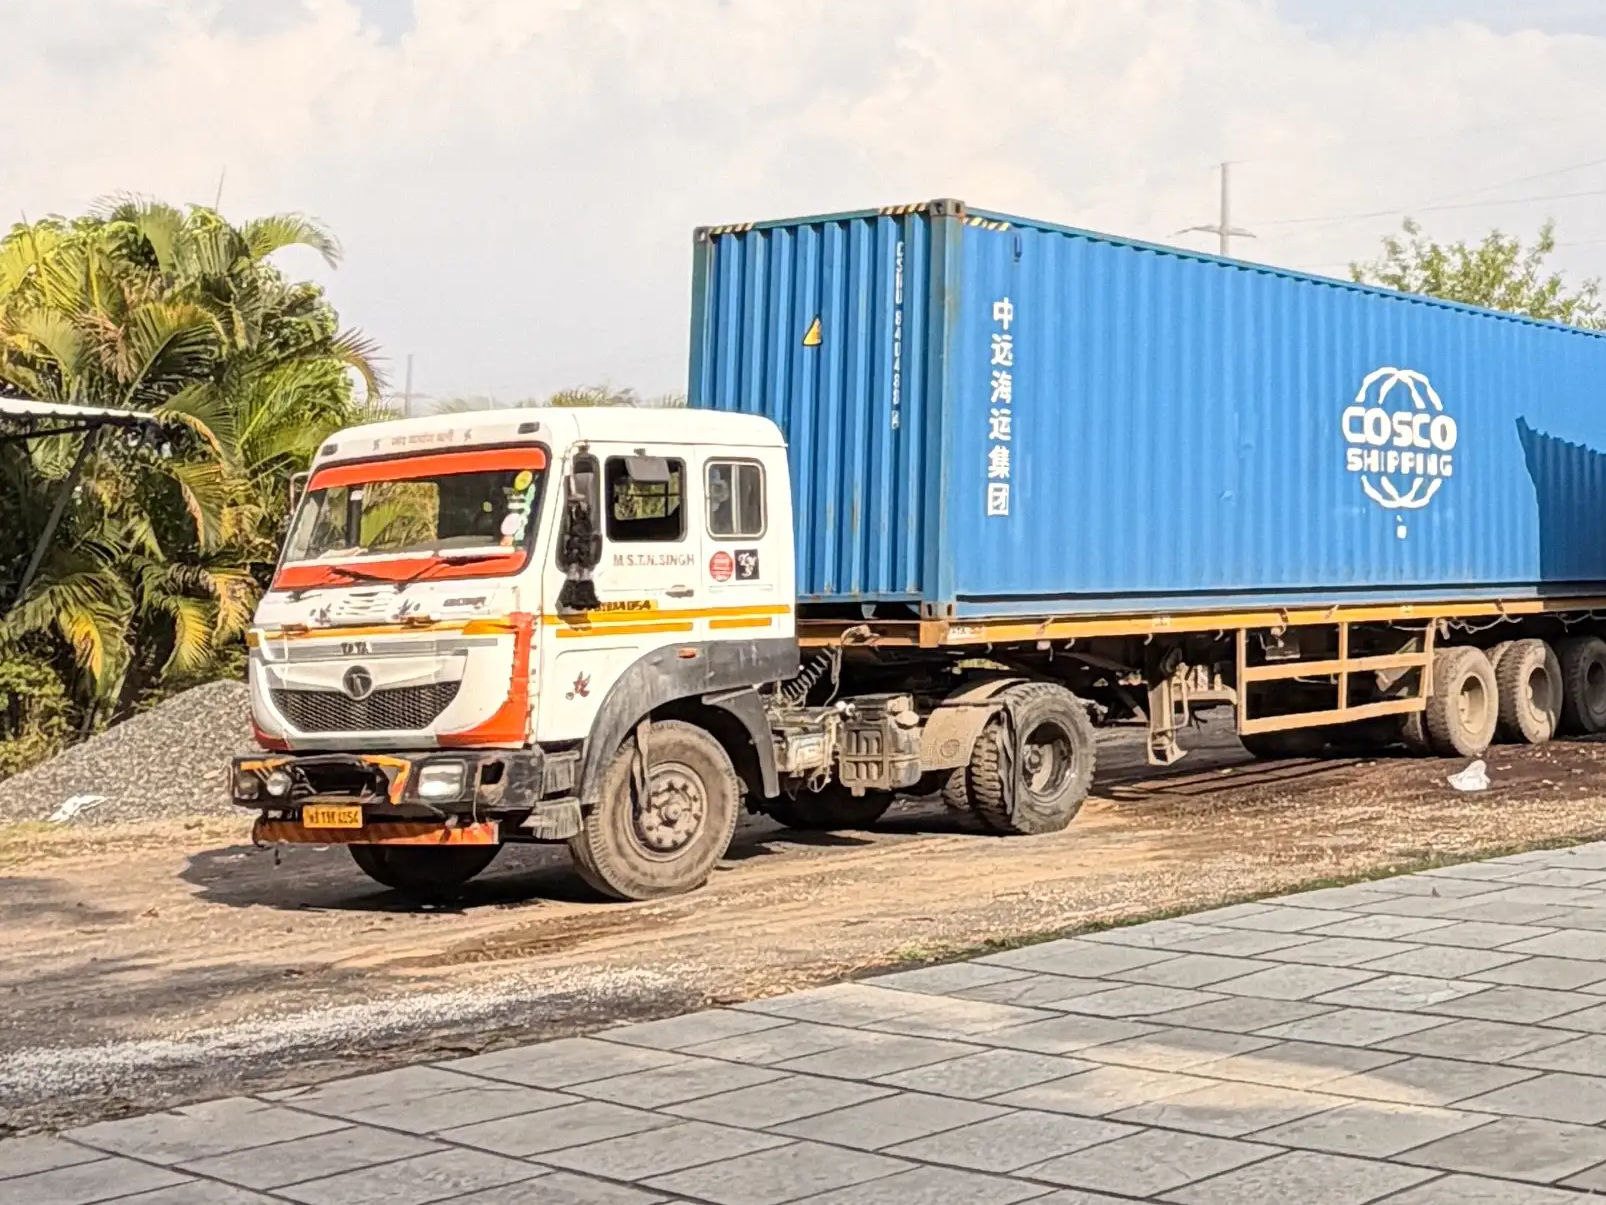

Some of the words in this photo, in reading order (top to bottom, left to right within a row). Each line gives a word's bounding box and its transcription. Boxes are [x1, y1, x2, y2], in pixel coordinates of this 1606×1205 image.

[987, 296, 1014, 516] 中远海运集团
[1341, 405, 1457, 451] COSCO
[1346, 447, 1453, 477] SHIPPING
